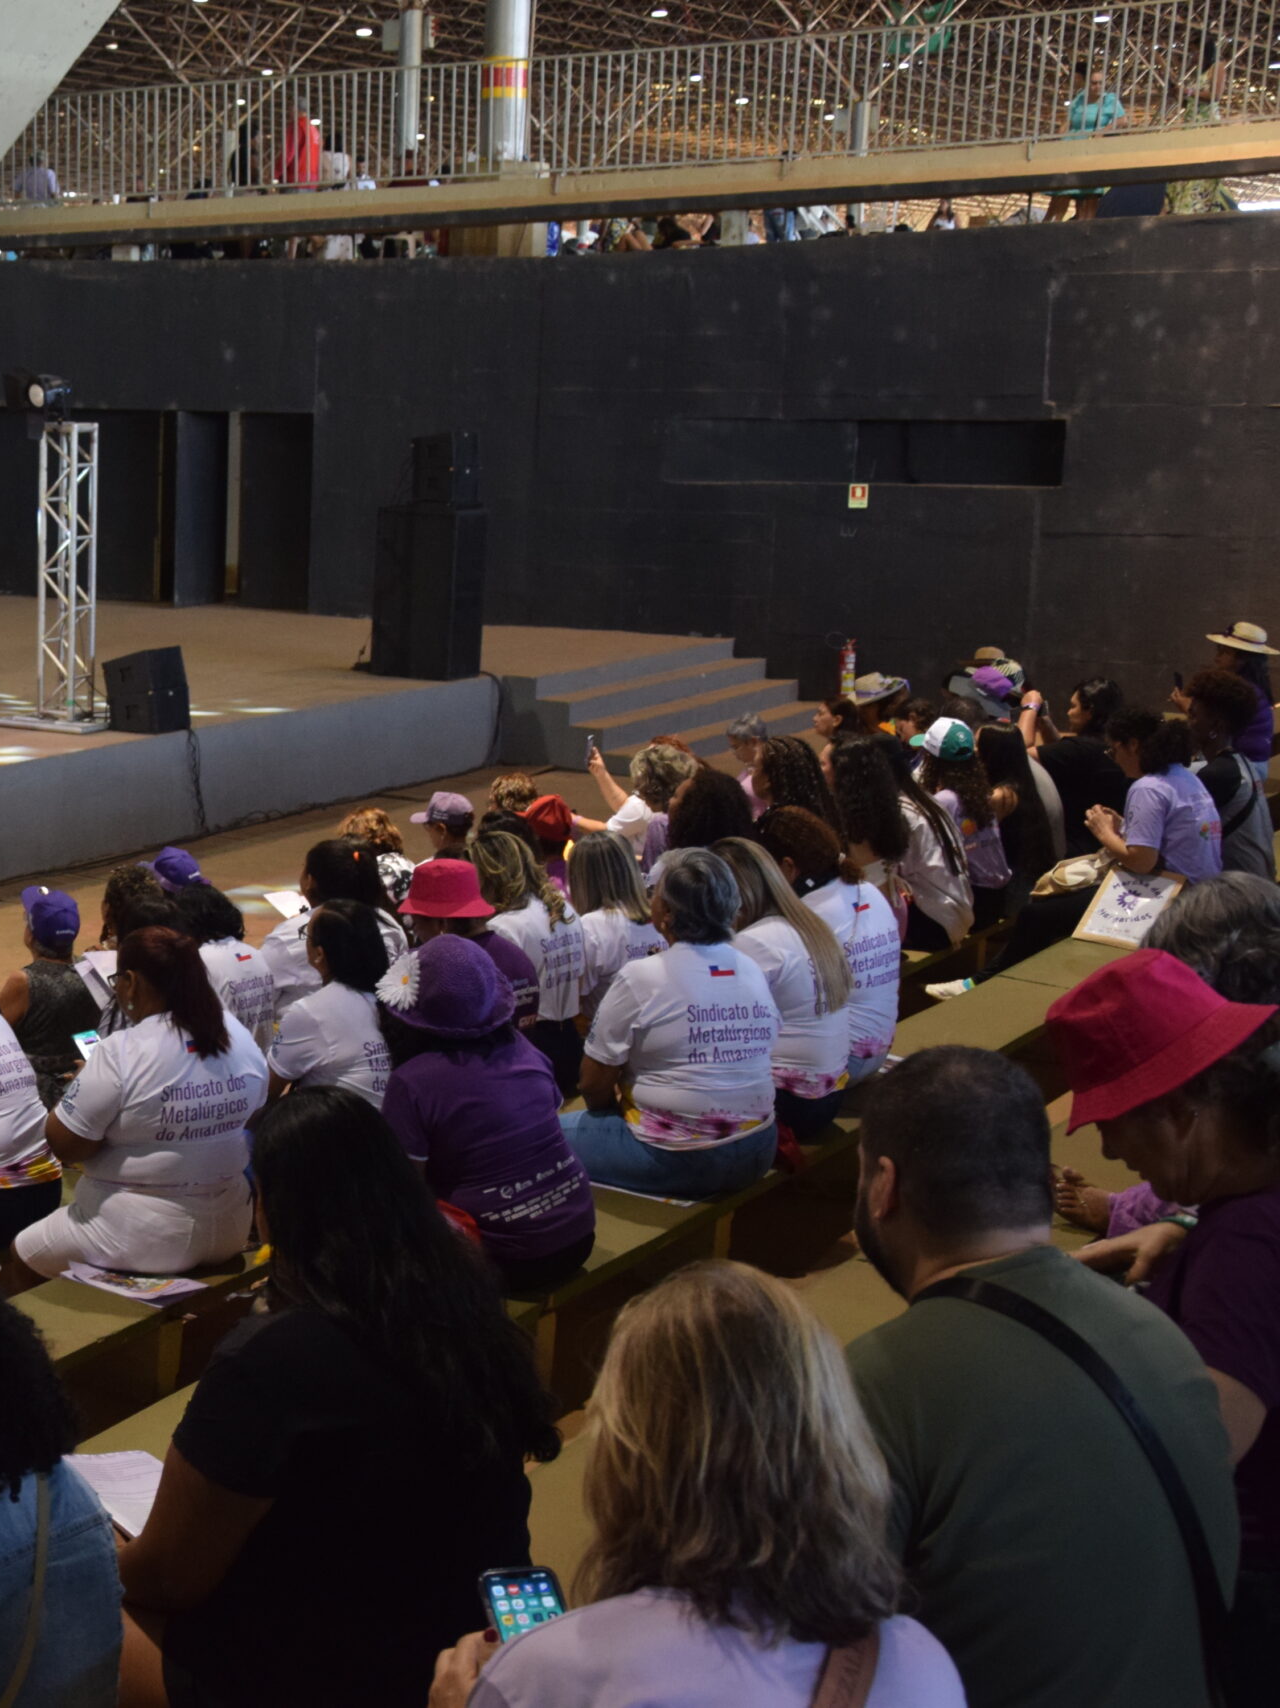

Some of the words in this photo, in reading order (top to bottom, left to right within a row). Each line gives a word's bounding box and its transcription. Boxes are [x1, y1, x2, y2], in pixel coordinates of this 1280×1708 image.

[687, 1003, 749, 1023] Sindicato
[688, 1024, 772, 1045] Metalúrgicos
[160, 1079, 224, 1103] Sindicato
[226, 1073, 247, 1093] dos
[160, 1097, 249, 1125] Metalúrgicos
[155, 1127, 176, 1141] do
